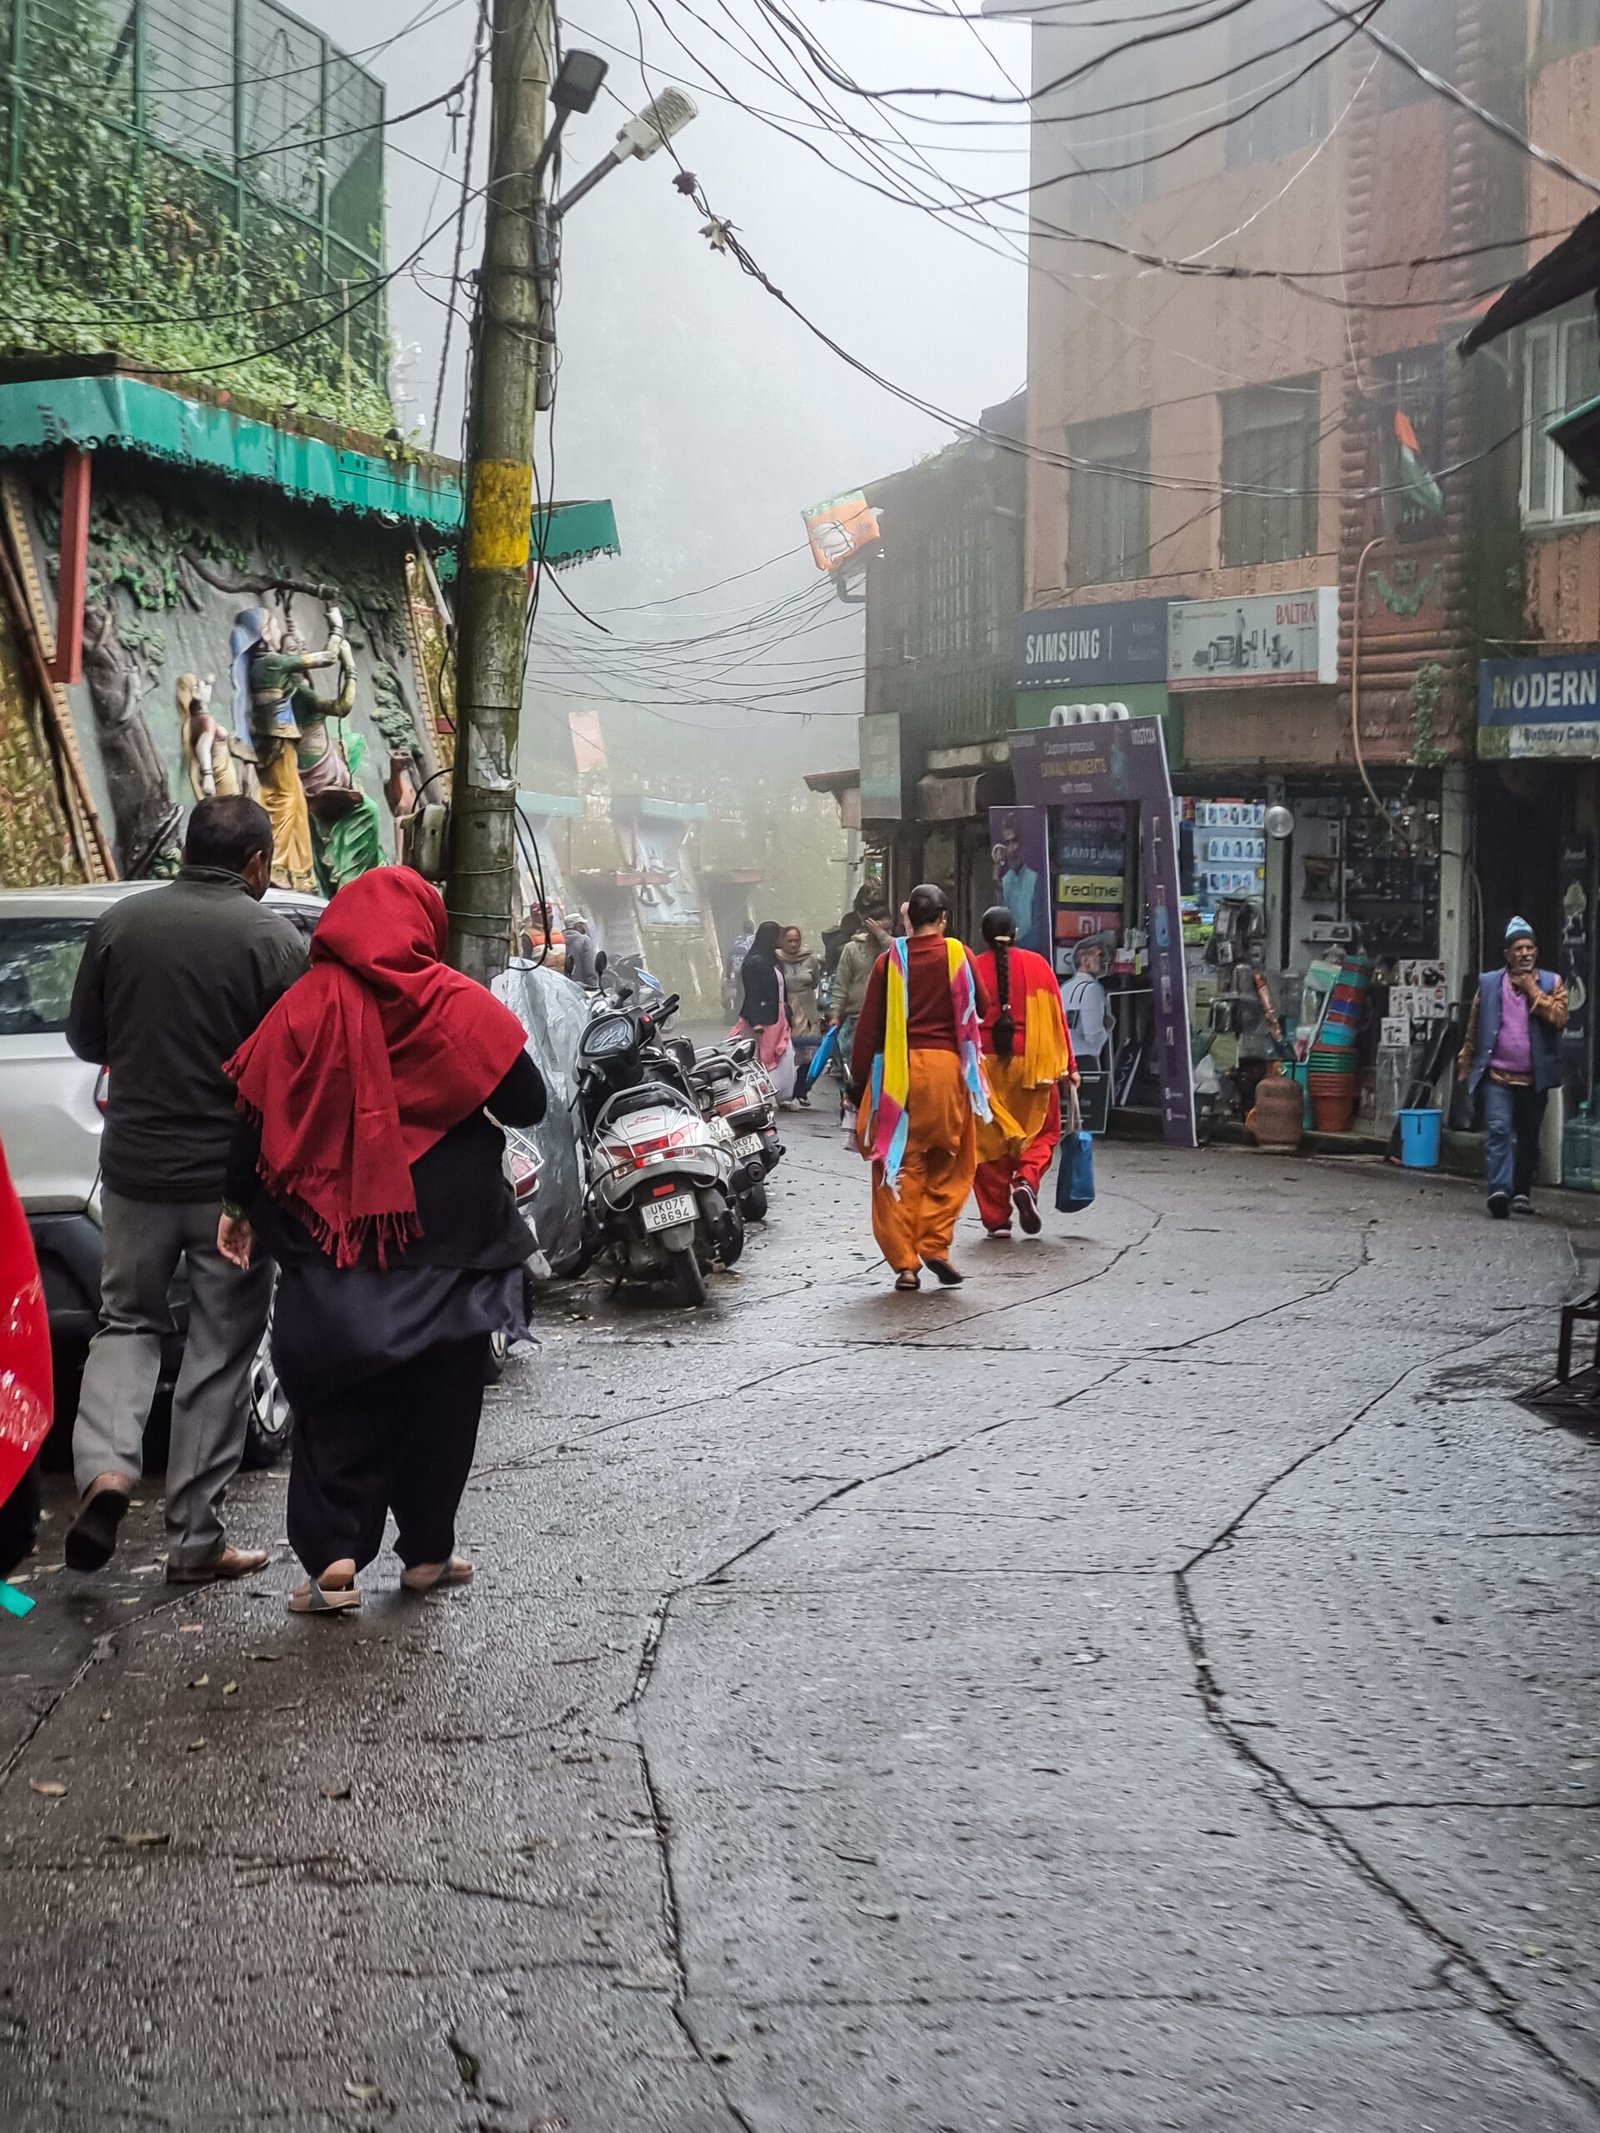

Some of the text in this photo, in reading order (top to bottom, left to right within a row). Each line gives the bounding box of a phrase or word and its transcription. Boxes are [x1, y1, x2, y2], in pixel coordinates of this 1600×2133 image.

[1276, 602, 1317, 625] BALTRA
[1026, 628, 1100, 665] SAMSUNG
[1493, 669, 1597, 709] MODERN
[1063, 846, 1122, 861] SAMSUNG
[1064, 882, 1118, 898] realme
[735, 1142, 761, 1158] A3571
[650, 1197, 686, 1215] UK07F
[653, 1208, 690, 1226] C8694
